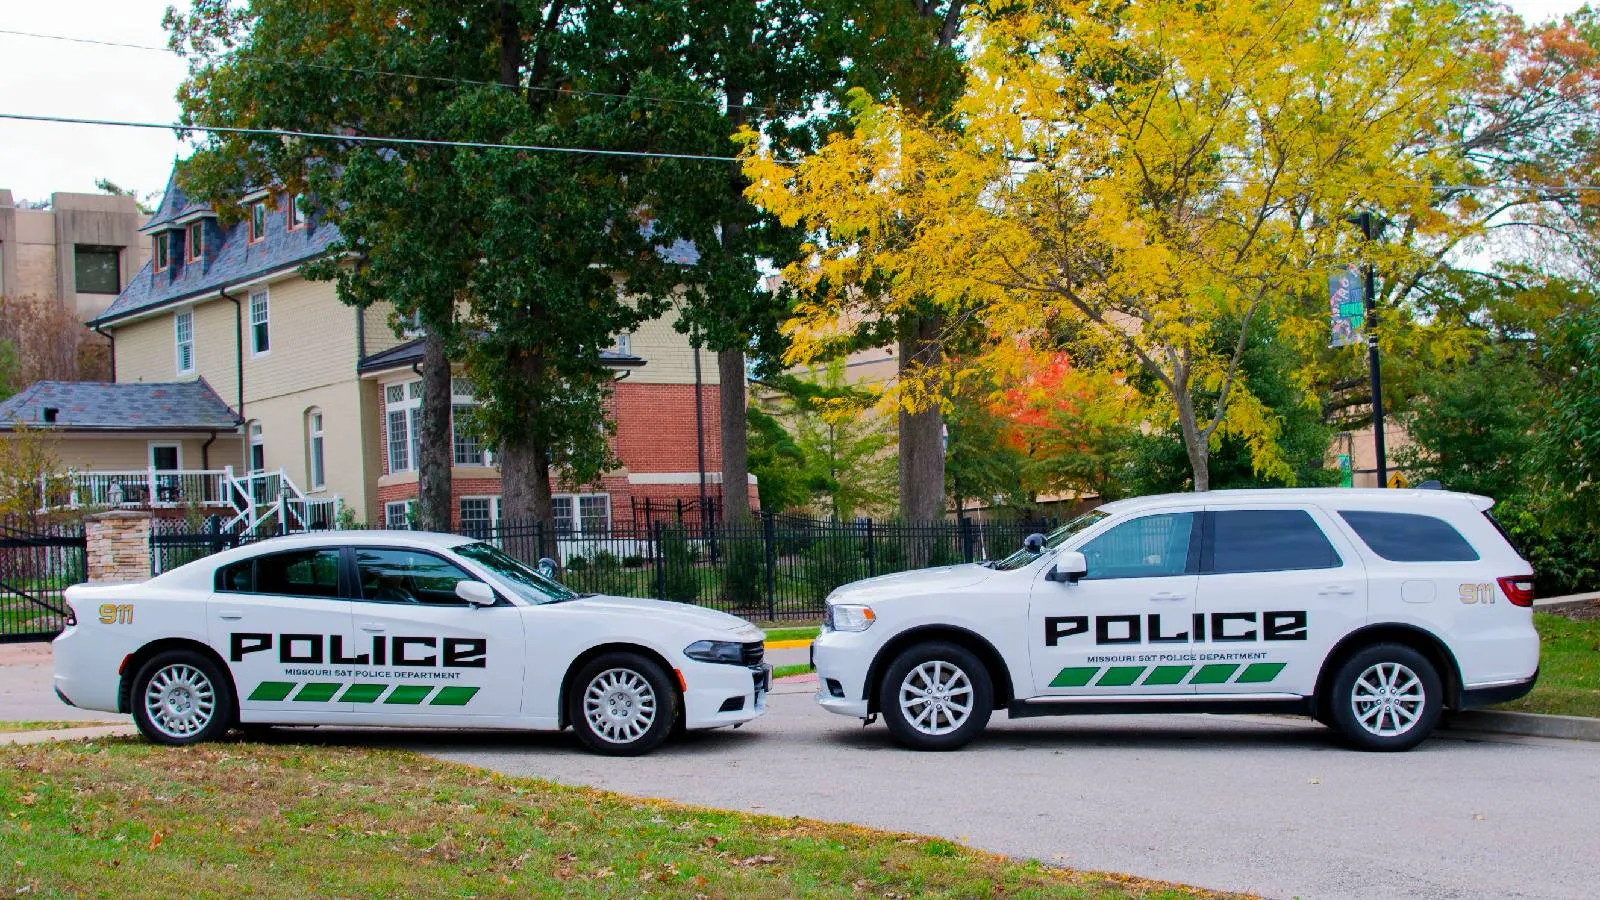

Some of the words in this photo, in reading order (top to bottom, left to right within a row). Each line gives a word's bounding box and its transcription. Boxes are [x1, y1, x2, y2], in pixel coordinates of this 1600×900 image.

[1458, 583, 1496, 605] 911
[98, 603, 134, 625] 911
[1044, 610, 1308, 647] POLICE
[230, 632, 487, 668] POLICE
[1087, 655, 1136, 663] MISSOURI
[1138, 654, 1158, 662] S&T
[1159, 653, 1197, 662] POLICE
[1199, 652, 1267, 661] DEPARTMENT
[285, 668, 332, 677] MISSOURI
[334, 669, 353, 677] S&T
[355, 670, 392, 678] POLICE
[394, 671, 461, 679] DEPARTMENT
